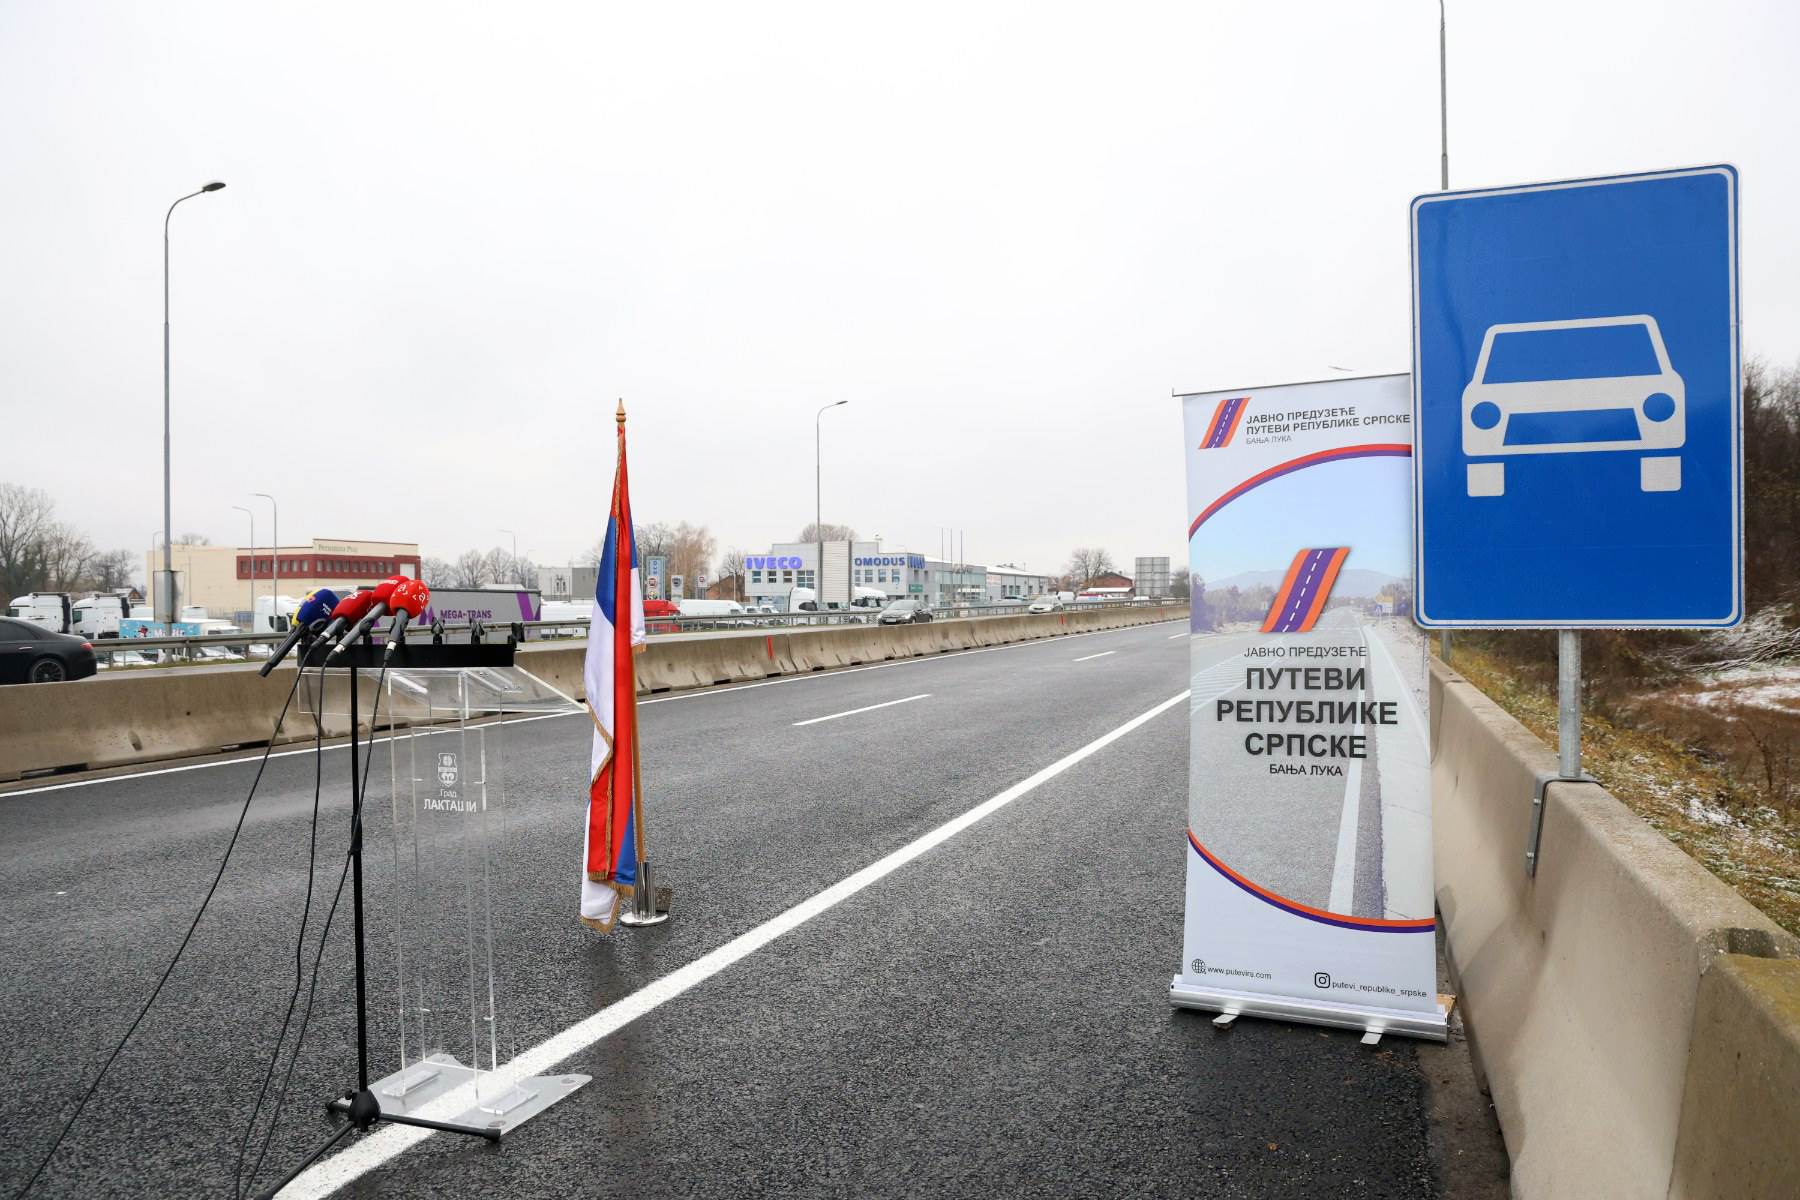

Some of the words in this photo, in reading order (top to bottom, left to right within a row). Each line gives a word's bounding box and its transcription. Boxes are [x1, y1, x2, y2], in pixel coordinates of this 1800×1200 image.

[1246, 412, 1284, 425] ЈАВНО
[1287, 406, 1356, 422] ПРЕДУЗЕЋЕ
[1246, 423, 1290, 435] ПУТЕВИ
[1293, 418, 1360, 432] РЕПУБЛИКЕ
[1363, 414, 1411, 426] СРПСКЕ
[1246, 435, 1269, 445] БАЊА
[1271, 434, 1292, 443] ЛУКА
[746, 556, 802, 570] IVECO
[440, 609, 492, 620] MEGA-TRANS
[1244, 646, 1286, 658] ЈАВНО
[1289, 646, 1367, 659] ПРЕДУЗЕЋЕ
[1246, 667, 1365, 690] ПУТЕВИ
[1217, 699, 1398, 725] РЕПУБЛИКЕ
[1245, 732, 1367, 758] СРПСКЕ
[1270, 763, 1307, 776] БАЊА
[1310, 765, 1343, 777] ЛУКА
[440, 788, 457, 798] Град
[1332, 980, 1428, 998] putevi_republike_srpske
